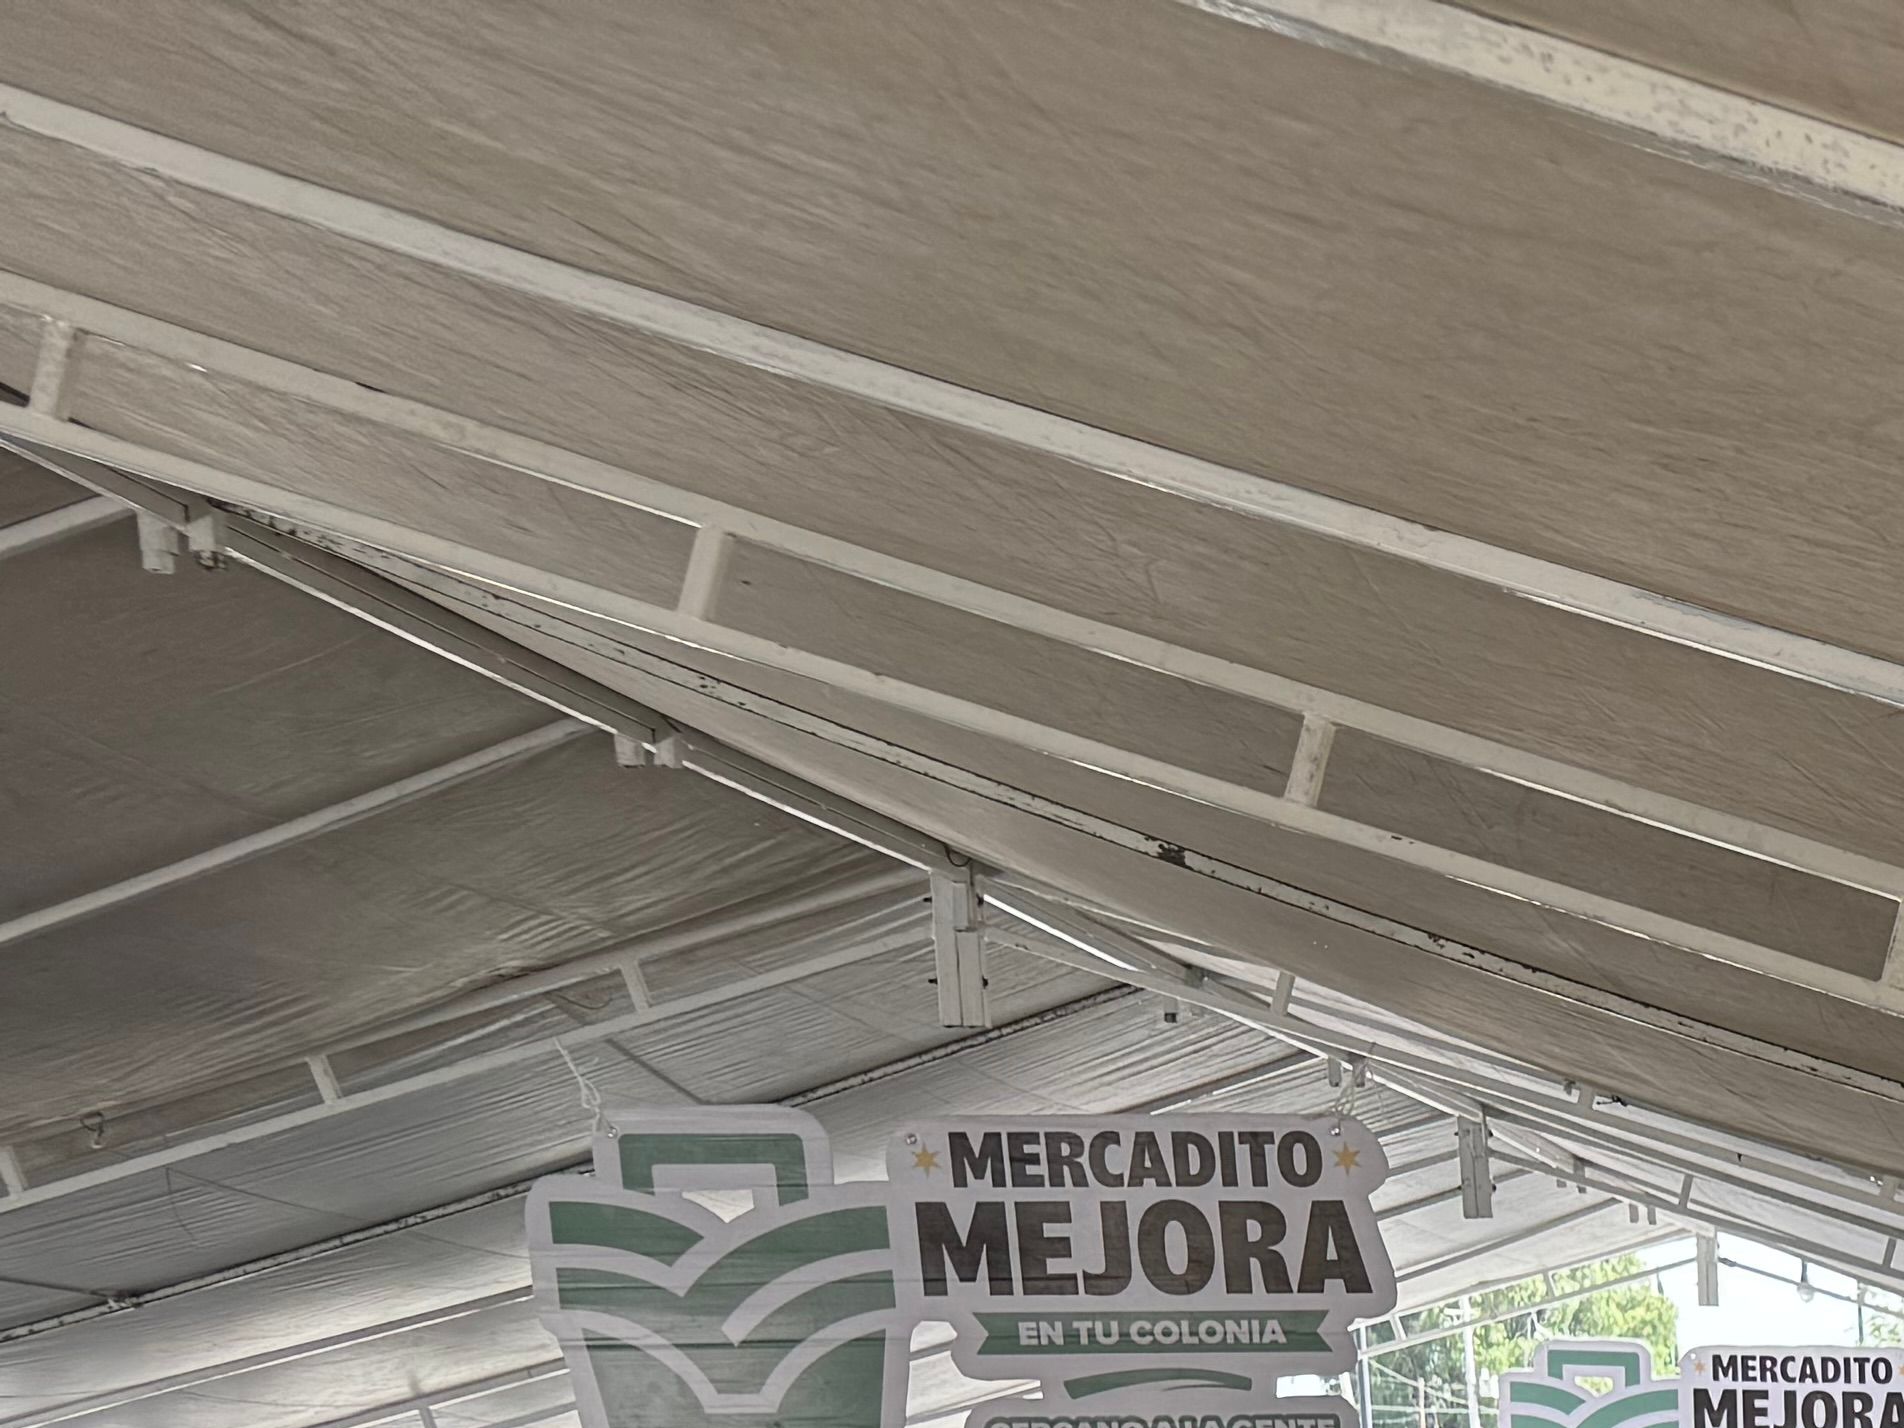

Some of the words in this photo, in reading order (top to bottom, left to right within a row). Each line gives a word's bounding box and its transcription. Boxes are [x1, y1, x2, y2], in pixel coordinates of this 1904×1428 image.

[949, 1129, 1323, 1190] MERCADITO
[914, 1199, 1373, 1297] MEJORA
[1018, 1321, 1065, 1348] EN
[1073, 1321, 1122, 1348] TU
[1129, 1319, 1288, 1347] COLONIA
[1711, 1354, 1894, 1385] MERCADITO
